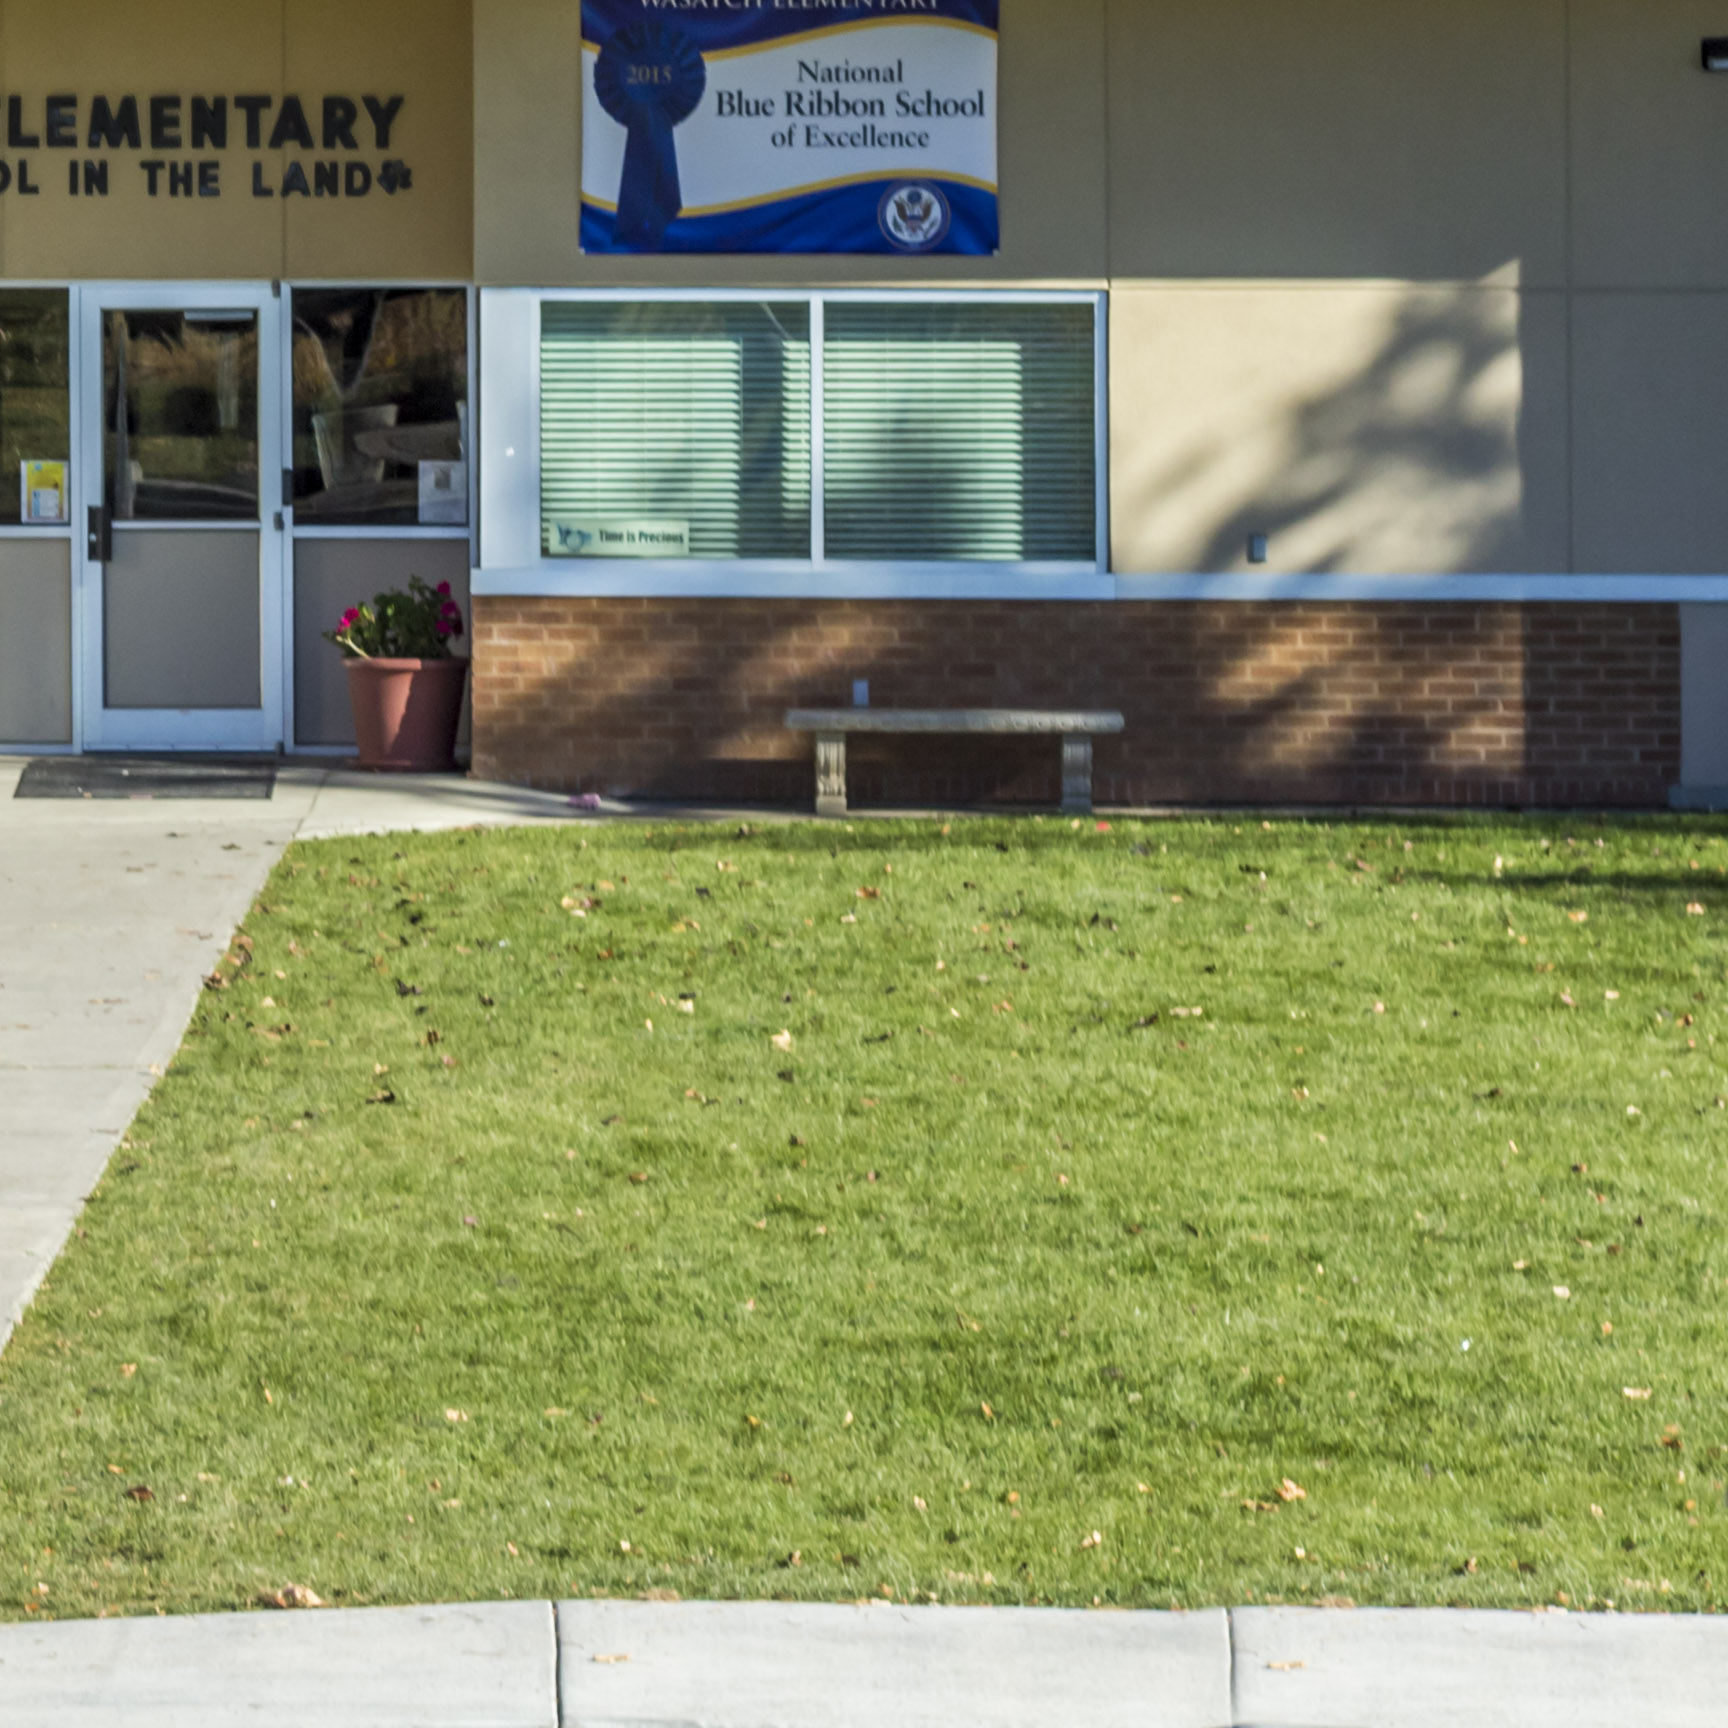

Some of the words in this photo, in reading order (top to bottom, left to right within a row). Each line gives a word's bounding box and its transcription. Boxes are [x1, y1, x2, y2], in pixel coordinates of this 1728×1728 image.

[797, 59, 903, 83] National
[716, 90, 775, 117] Blue
[786, 90, 886, 117] Ribbon
[896, 90, 984, 117] School
[771, 124, 797, 147] of
[804, 124, 930, 148] Excellence
[69, 159, 109, 196] IN
[139, 159, 221, 198] THE
[252, 159, 373, 198] LAND
[599, 529, 624, 543] Time
[627, 529, 636, 543] is
[639, 530, 684, 544] Precious
